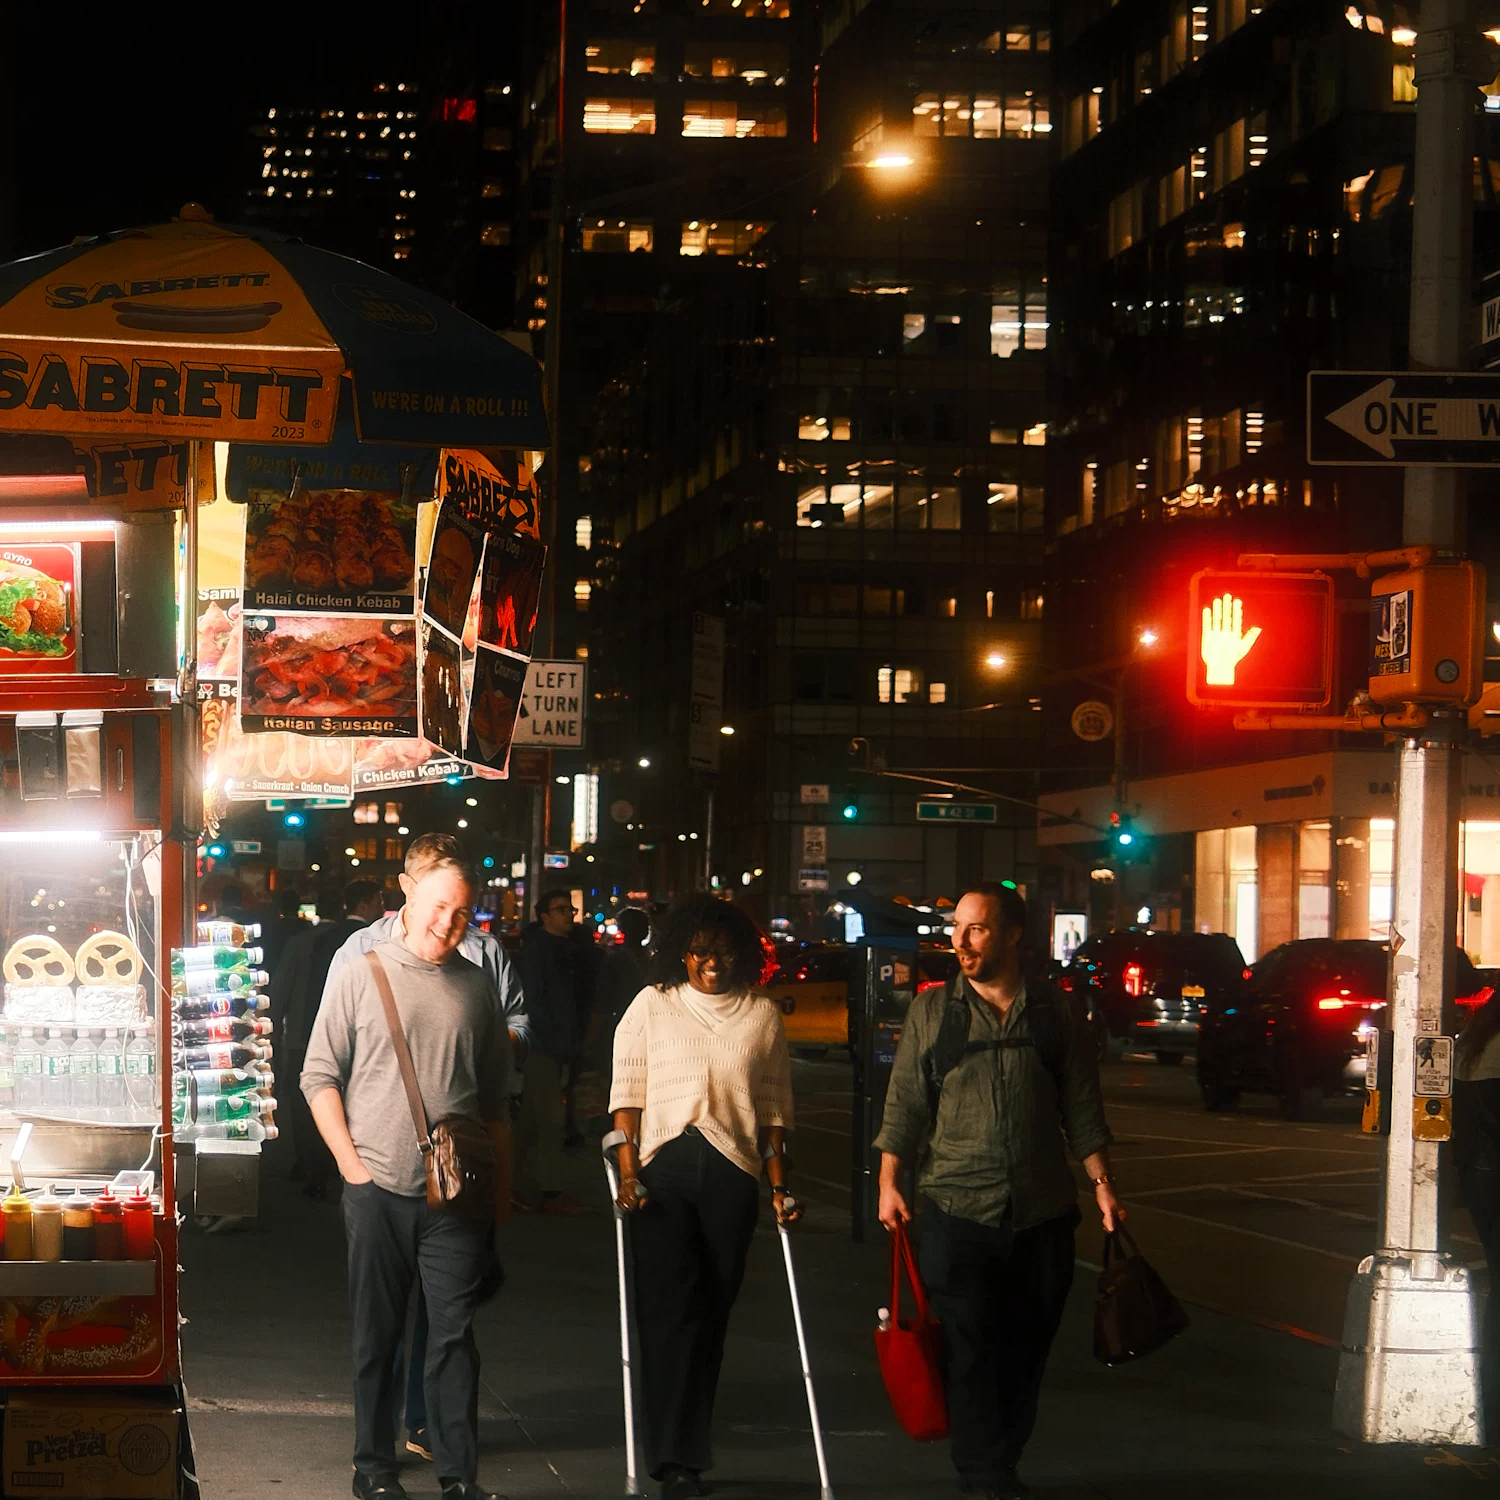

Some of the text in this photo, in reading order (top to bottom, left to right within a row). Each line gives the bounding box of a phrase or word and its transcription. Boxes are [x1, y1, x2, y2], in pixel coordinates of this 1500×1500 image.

[46, 273, 269, 308] SABRETT
[371, 390, 419, 414] WE'RE
[424, 393, 445, 414] ON
[449, 395, 461, 414] A
[465, 395, 504, 416] ROLL
[1364, 402, 1438, 436] ONE
[271, 425, 305, 439] 2023
[168, 491, 188, 503] 202
[3, 551, 33, 567] GYRO
[296, 594, 352, 608] Chicken
[356, 595, 401, 609] Kebab
[536, 672, 577, 689] LEFT
[534, 696, 578, 712] TURN
[320, 717, 395, 734] Sausage
[532, 719, 577, 736] LANE
[362, 762, 460, 784] Chicken Kebab
[252, 781, 295, 792] Sauerkraut
[301, 782, 323, 793] Onion
[324, 782, 349, 794] Crunch
[805, 841, 823, 852] 25
[880, 964, 893, 981] P
[25, 1433, 107, 1466] Pretzel
